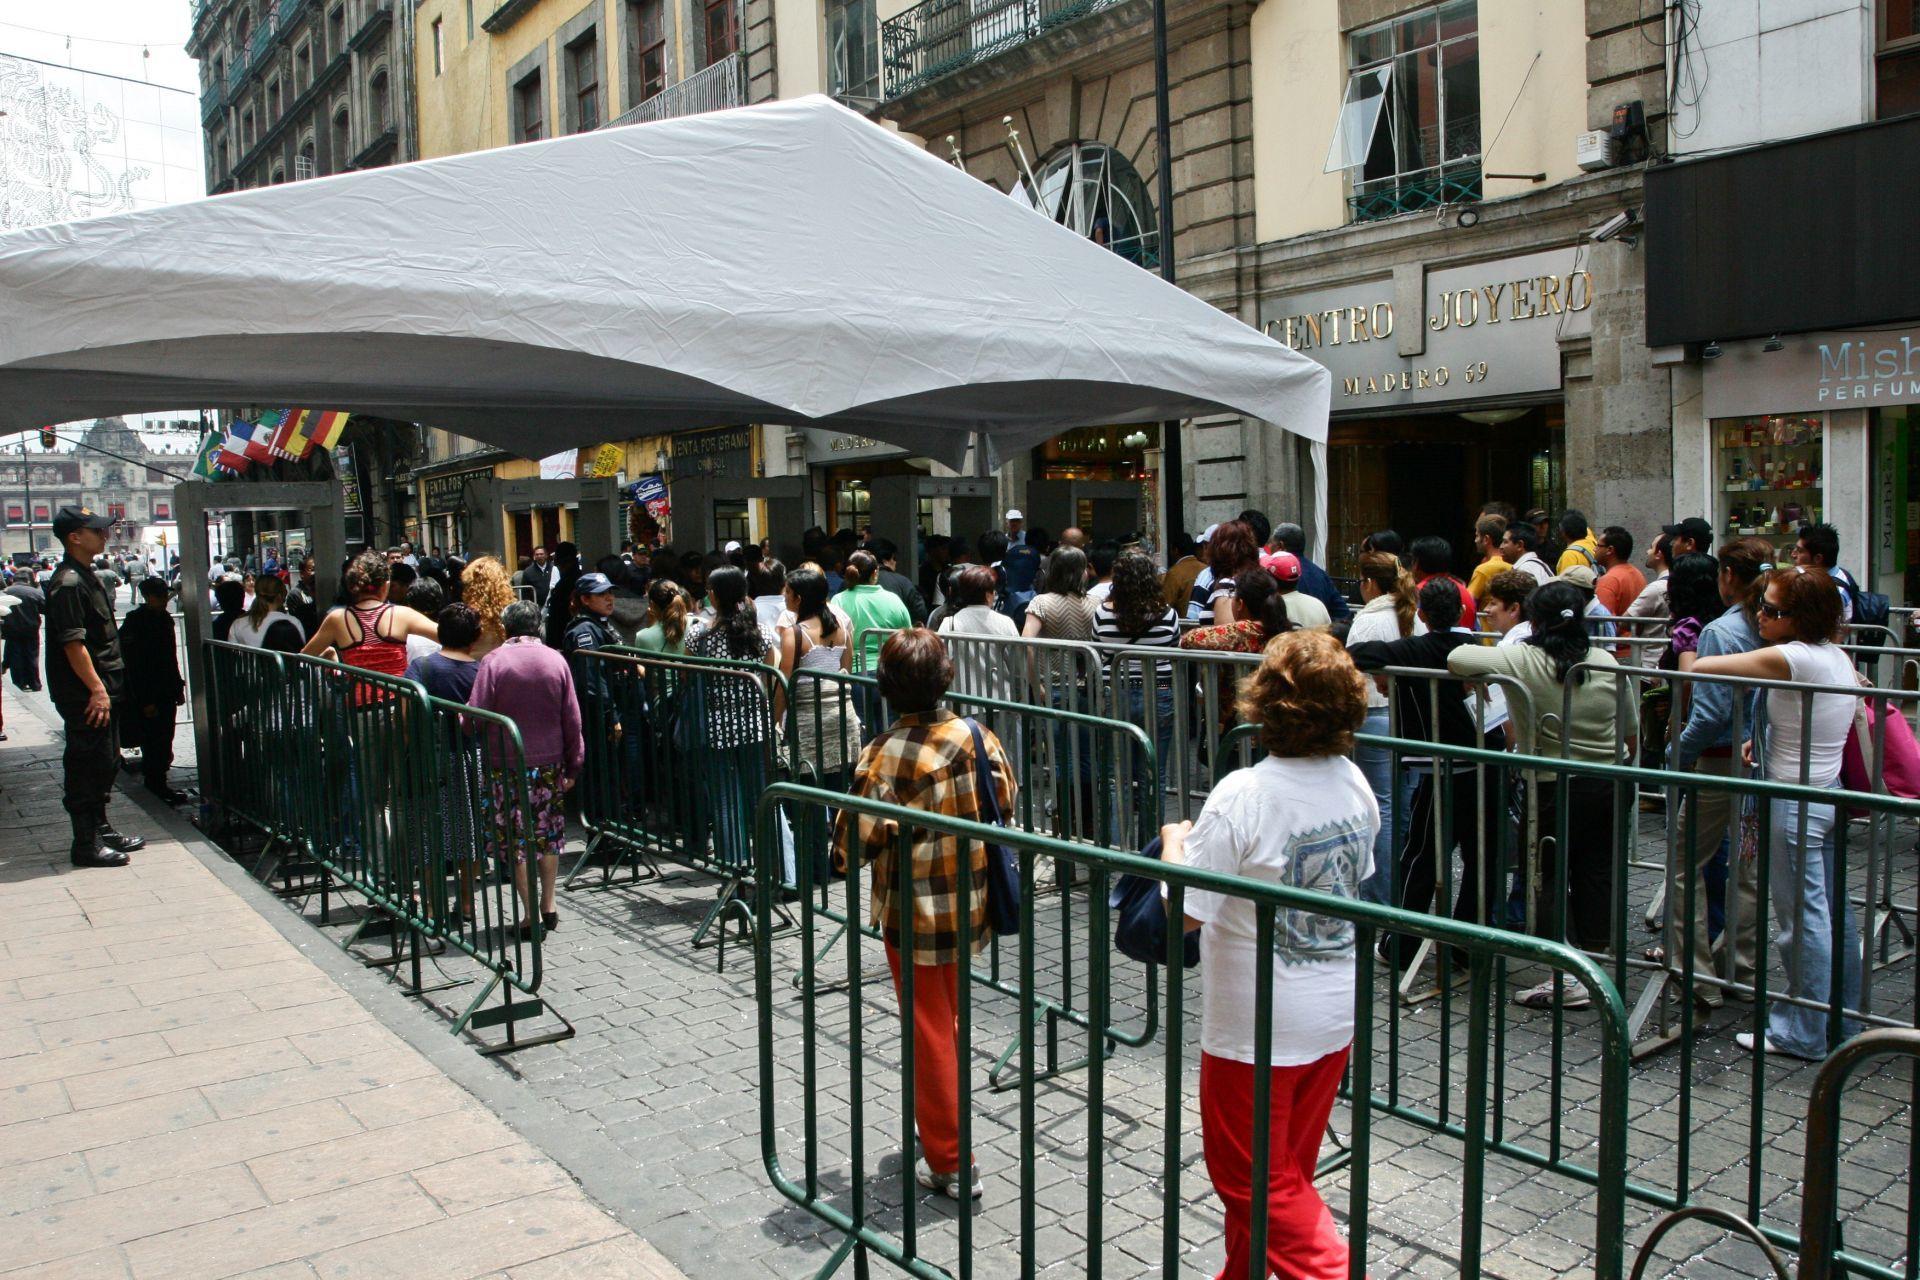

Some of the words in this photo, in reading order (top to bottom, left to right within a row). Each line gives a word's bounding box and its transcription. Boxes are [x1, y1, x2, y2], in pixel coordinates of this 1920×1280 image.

[1264, 302, 1394, 351] CENTRO
[1429, 270, 1593, 332] JOYERO
[1818, 336, 1920, 383] Mish
[1343, 366, 1449, 397] MADERO
[1464, 361, 1489, 384] 69
[1818, 380, 1920, 402] PERFUM
[672, 439, 699, 457] VENTA
